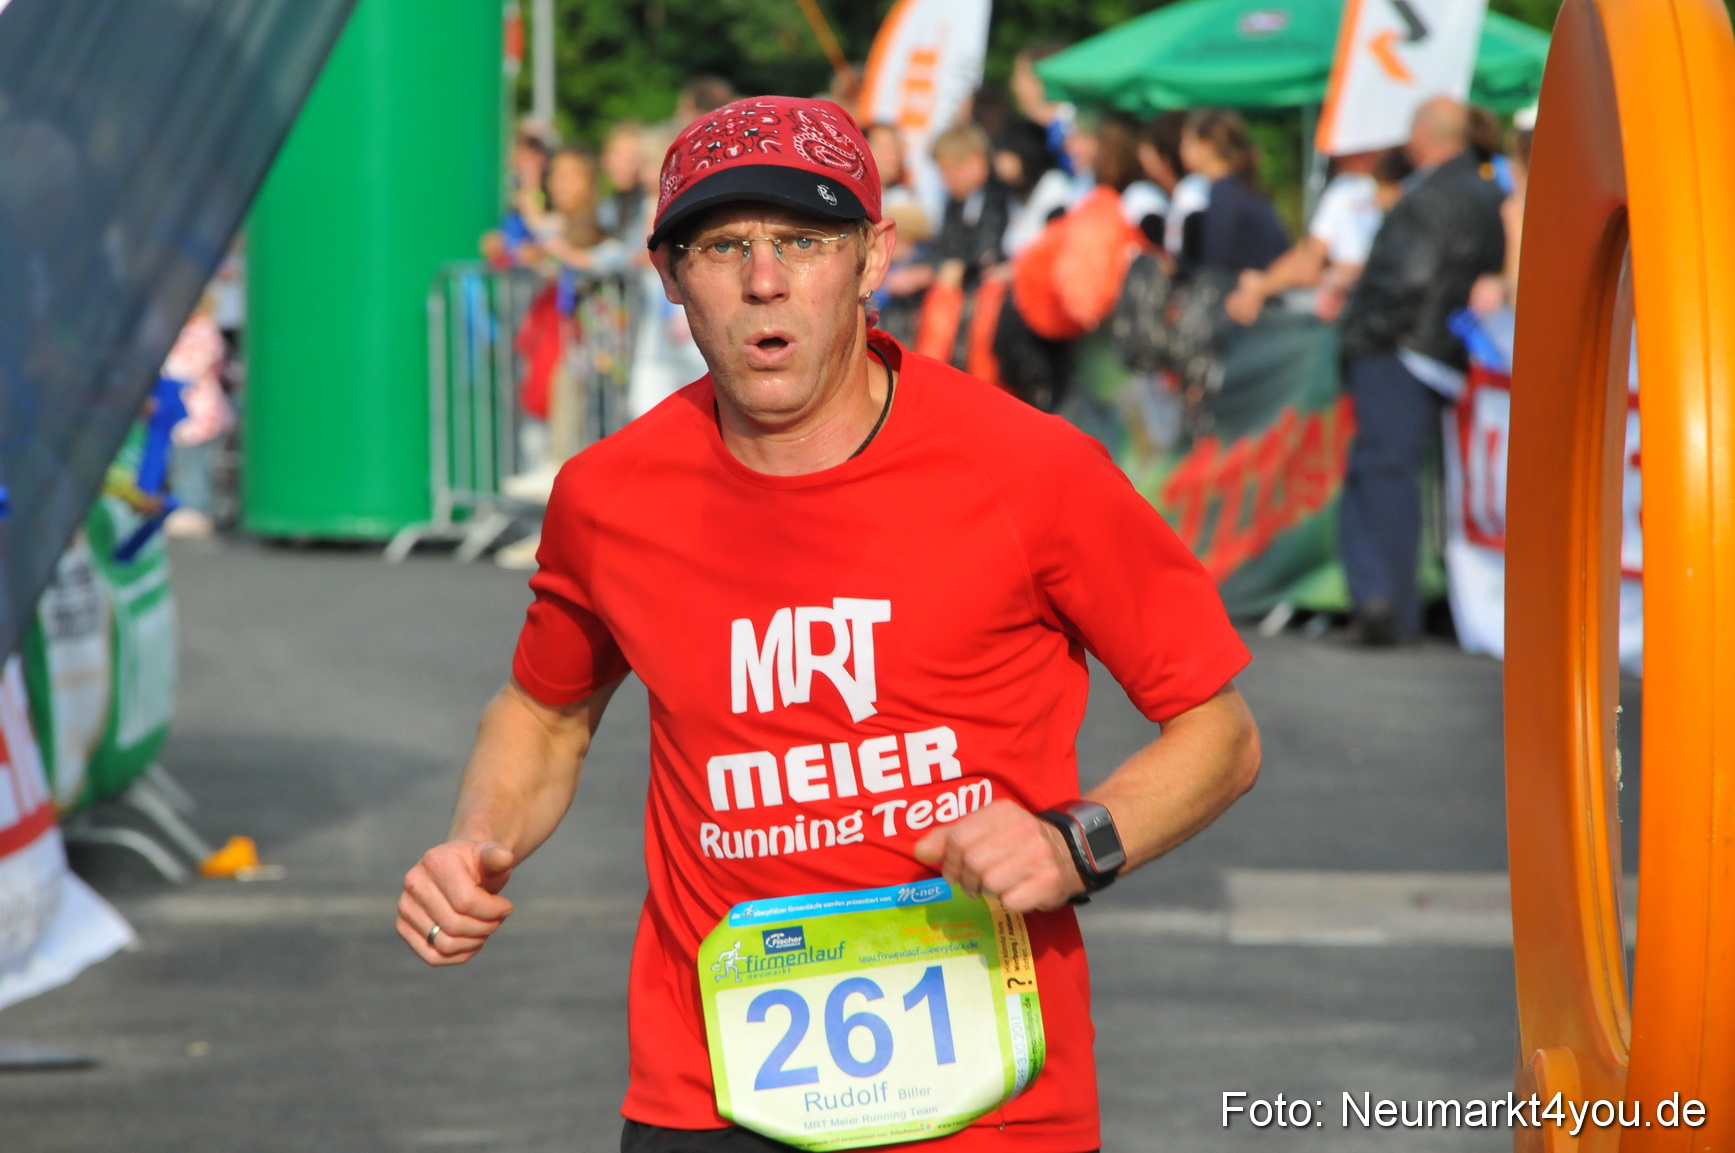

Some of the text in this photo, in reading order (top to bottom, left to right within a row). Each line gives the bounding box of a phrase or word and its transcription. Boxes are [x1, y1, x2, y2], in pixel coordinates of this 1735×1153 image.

[730, 597, 892, 724] MRT
[706, 725, 963, 812] MEIER
[700, 778, 993, 860] Running Team
[746, 941, 846, 973] firmenlauf
[748, 968, 791, 980] neumarkt
[1007, 977, 1033, 990] ?
[746, 965, 956, 1091] 261
[804, 1081, 931, 1112] Rudolf Biller
[803, 1105, 939, 1131] MRT Meier Running Team
